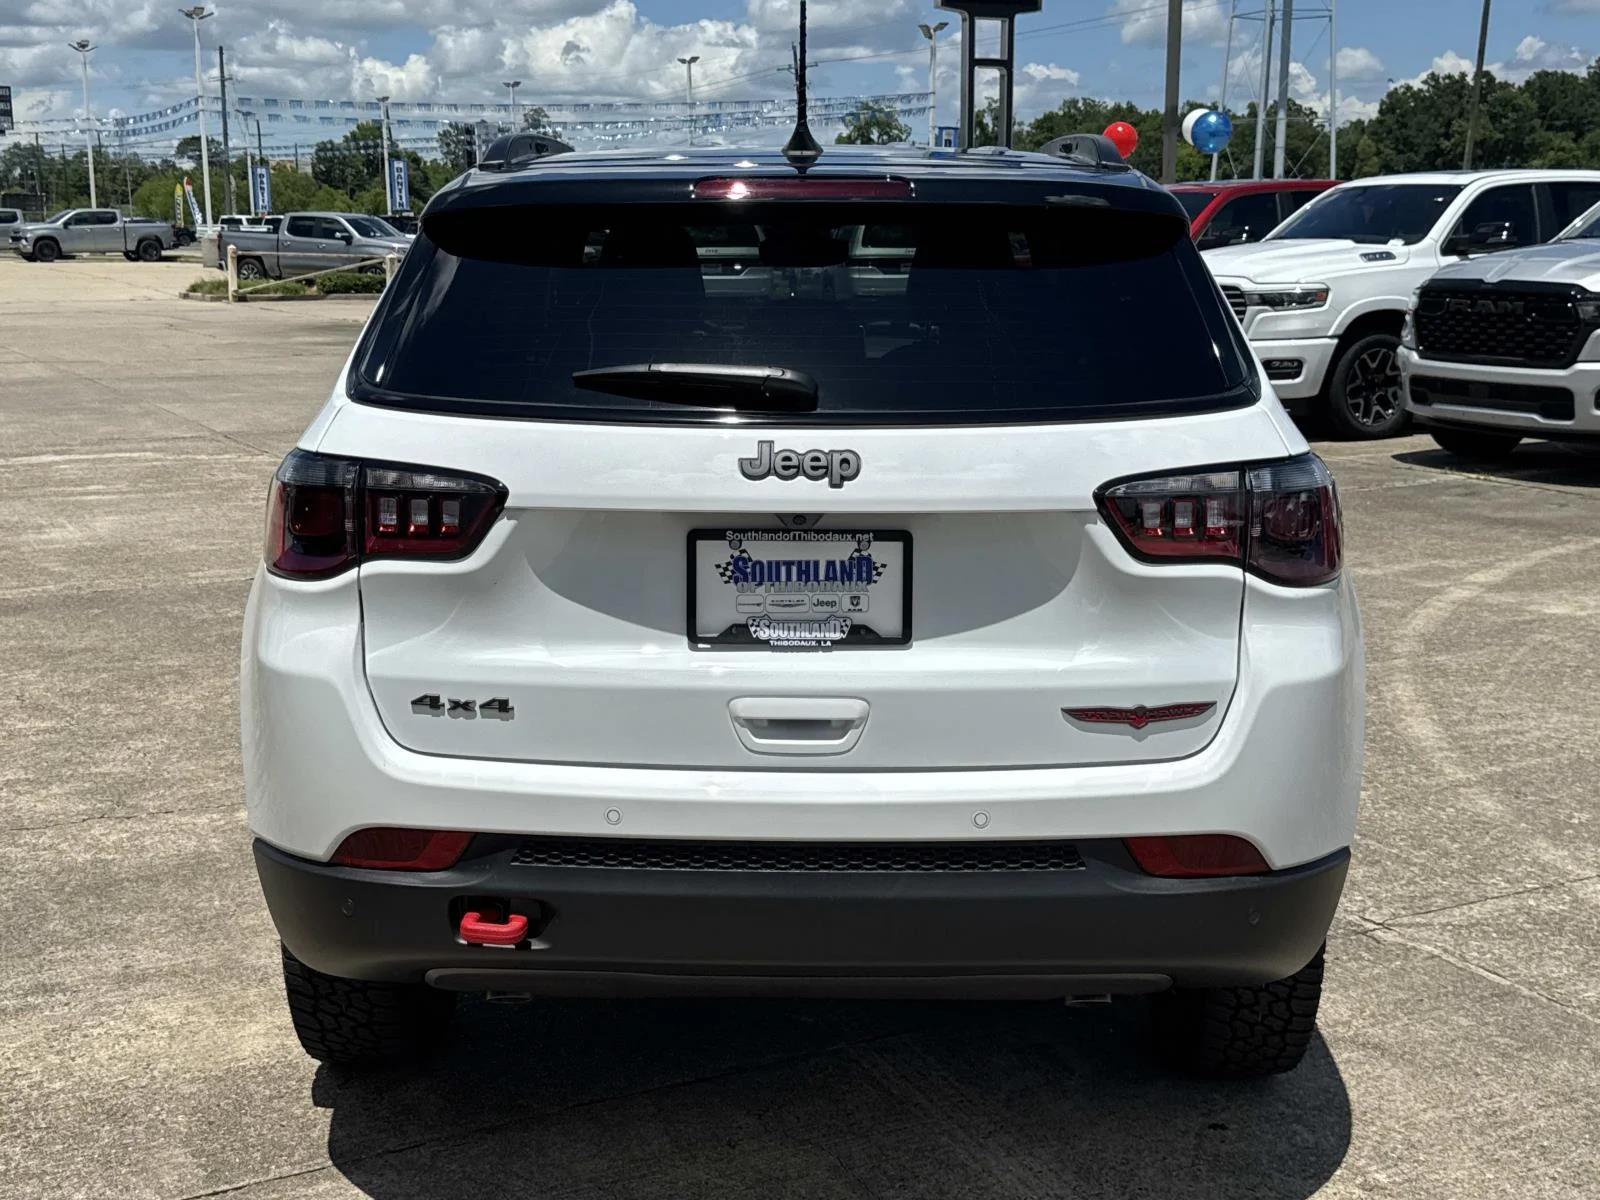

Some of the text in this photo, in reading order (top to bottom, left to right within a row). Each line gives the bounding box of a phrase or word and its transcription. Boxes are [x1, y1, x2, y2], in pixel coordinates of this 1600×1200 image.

[1450, 298, 1525, 315] RAM
[738, 440, 862, 489] Jeep
[726, 530, 875, 542] SouthlandofThibodaux.net
[732, 555, 874, 586] SOUTHLAND
[812, 598, 838, 609] Jeep
[758, 618, 843, 640] SOUTHLAND
[410, 693, 515, 717] 4x4
